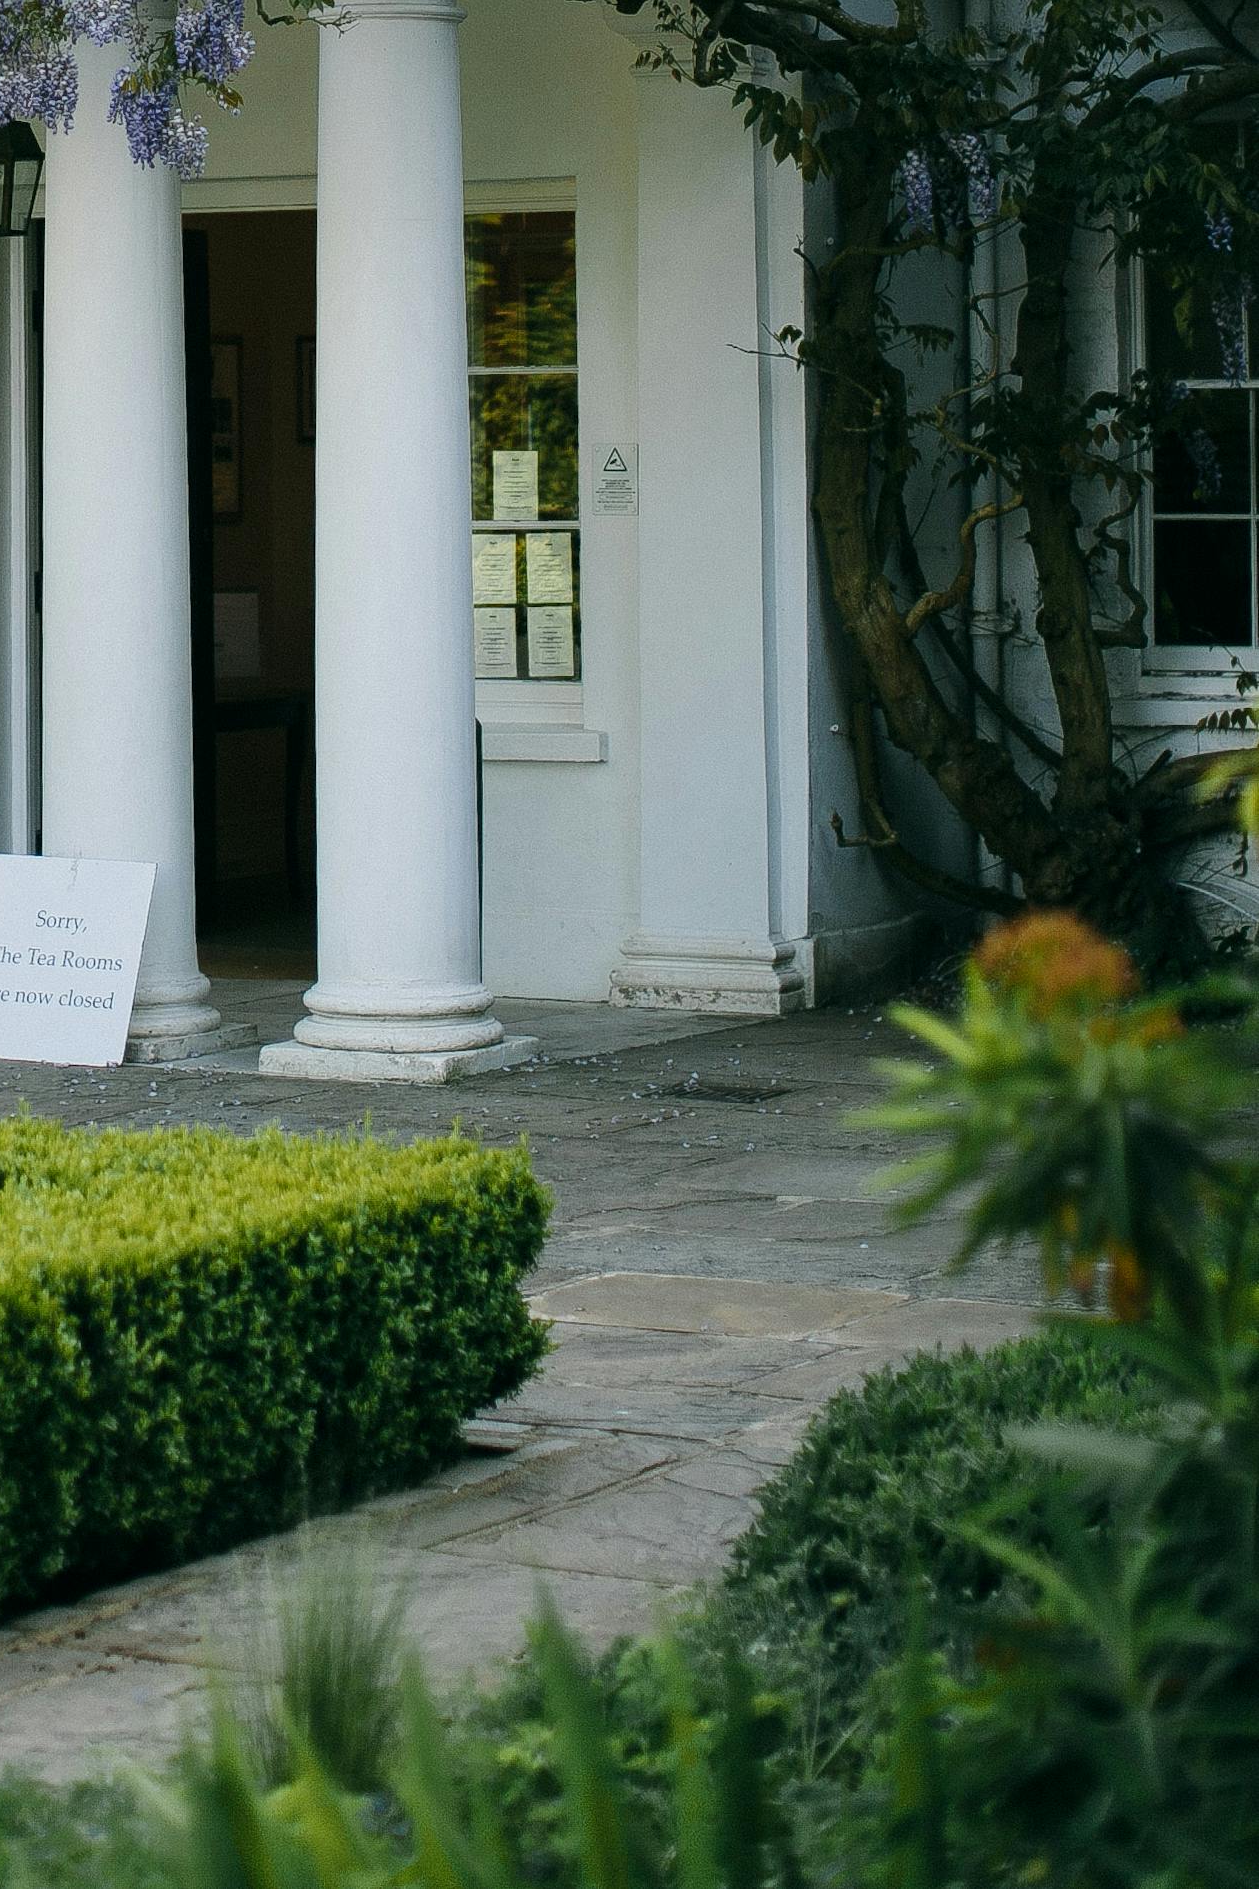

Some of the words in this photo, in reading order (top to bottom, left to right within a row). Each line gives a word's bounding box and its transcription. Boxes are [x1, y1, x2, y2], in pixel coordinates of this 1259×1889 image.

[35, 909, 88, 935] Sorry,
[27, 947, 56, 966] Tea
[62, 950, 123, 971] Rooms
[15, 989, 54, 1005] now
[59, 989, 115, 1010] closed
